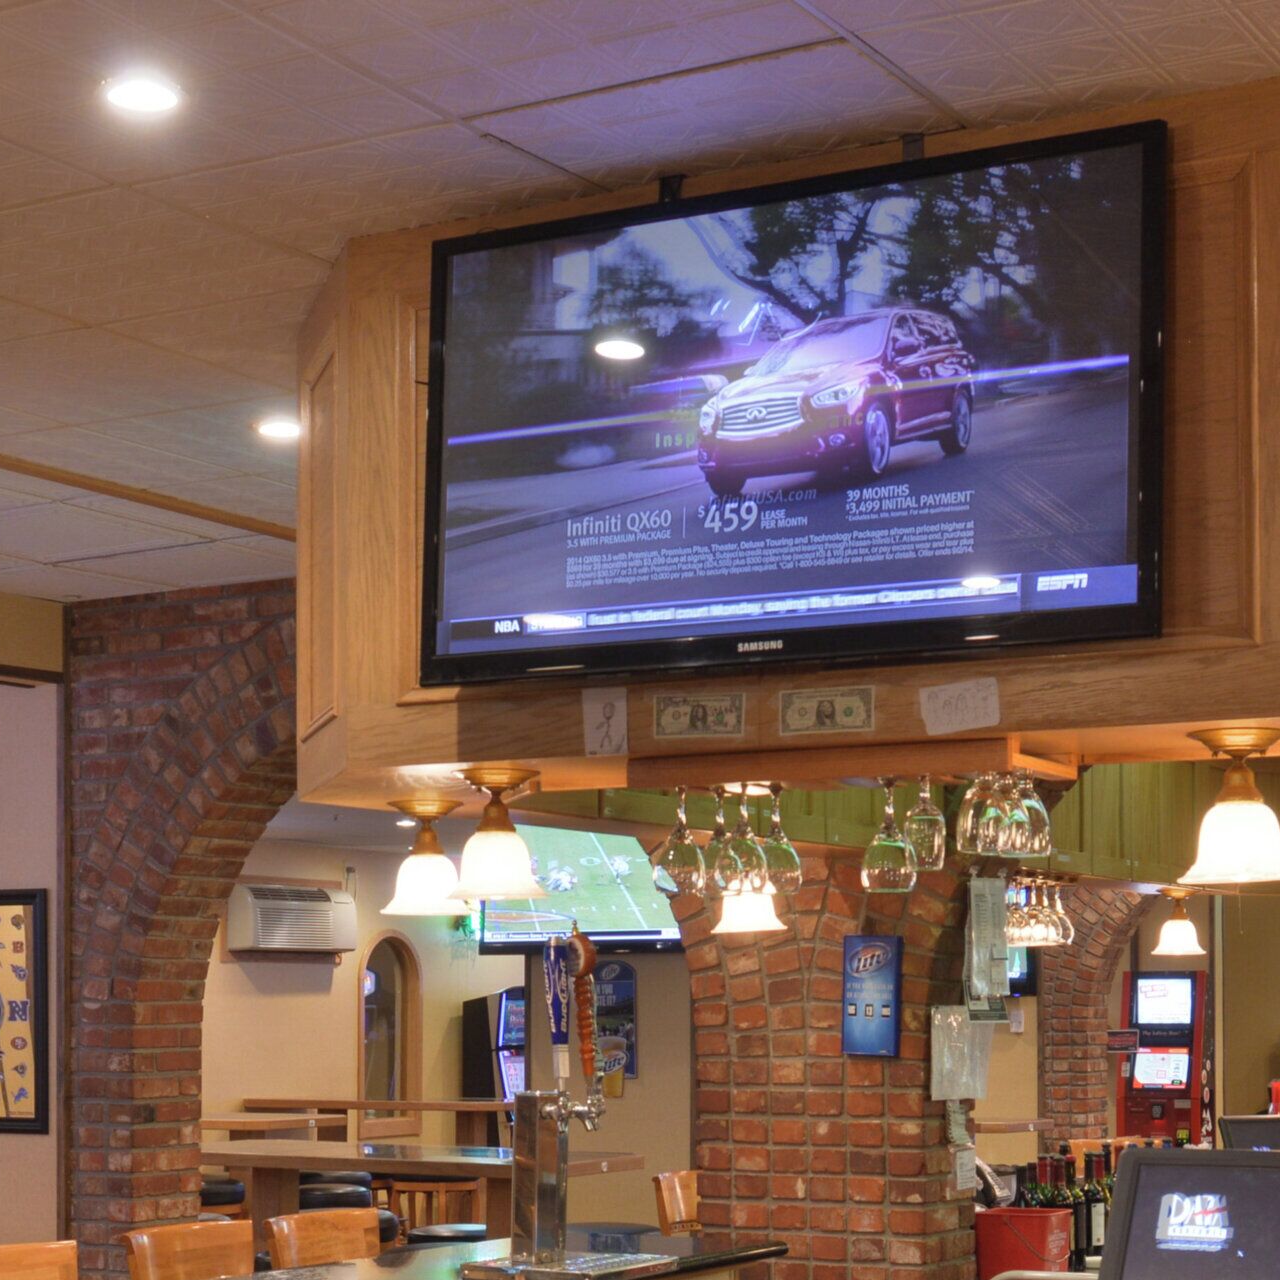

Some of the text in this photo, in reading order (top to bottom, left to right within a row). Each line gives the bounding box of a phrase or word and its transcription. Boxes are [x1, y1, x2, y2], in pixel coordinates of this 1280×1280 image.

[846, 484, 910, 502] 39 MONTHS
[846, 500, 880, 514] $3,499
[882, 497, 918, 511] INITIAL
[566, 509, 672, 537] Infiniti QX60
[697, 500, 758, 534] $459
[761, 509, 786, 520] LEASE
[761, 516, 808, 529] PER MONTH
[567, 529, 672, 549] 3.5 WITH PREMIUM PACKAGE
[1036, 573, 1089, 592] ESPN
[494, 619, 520, 634] NBA
[736, 639, 784, 653] SAMSUNG
